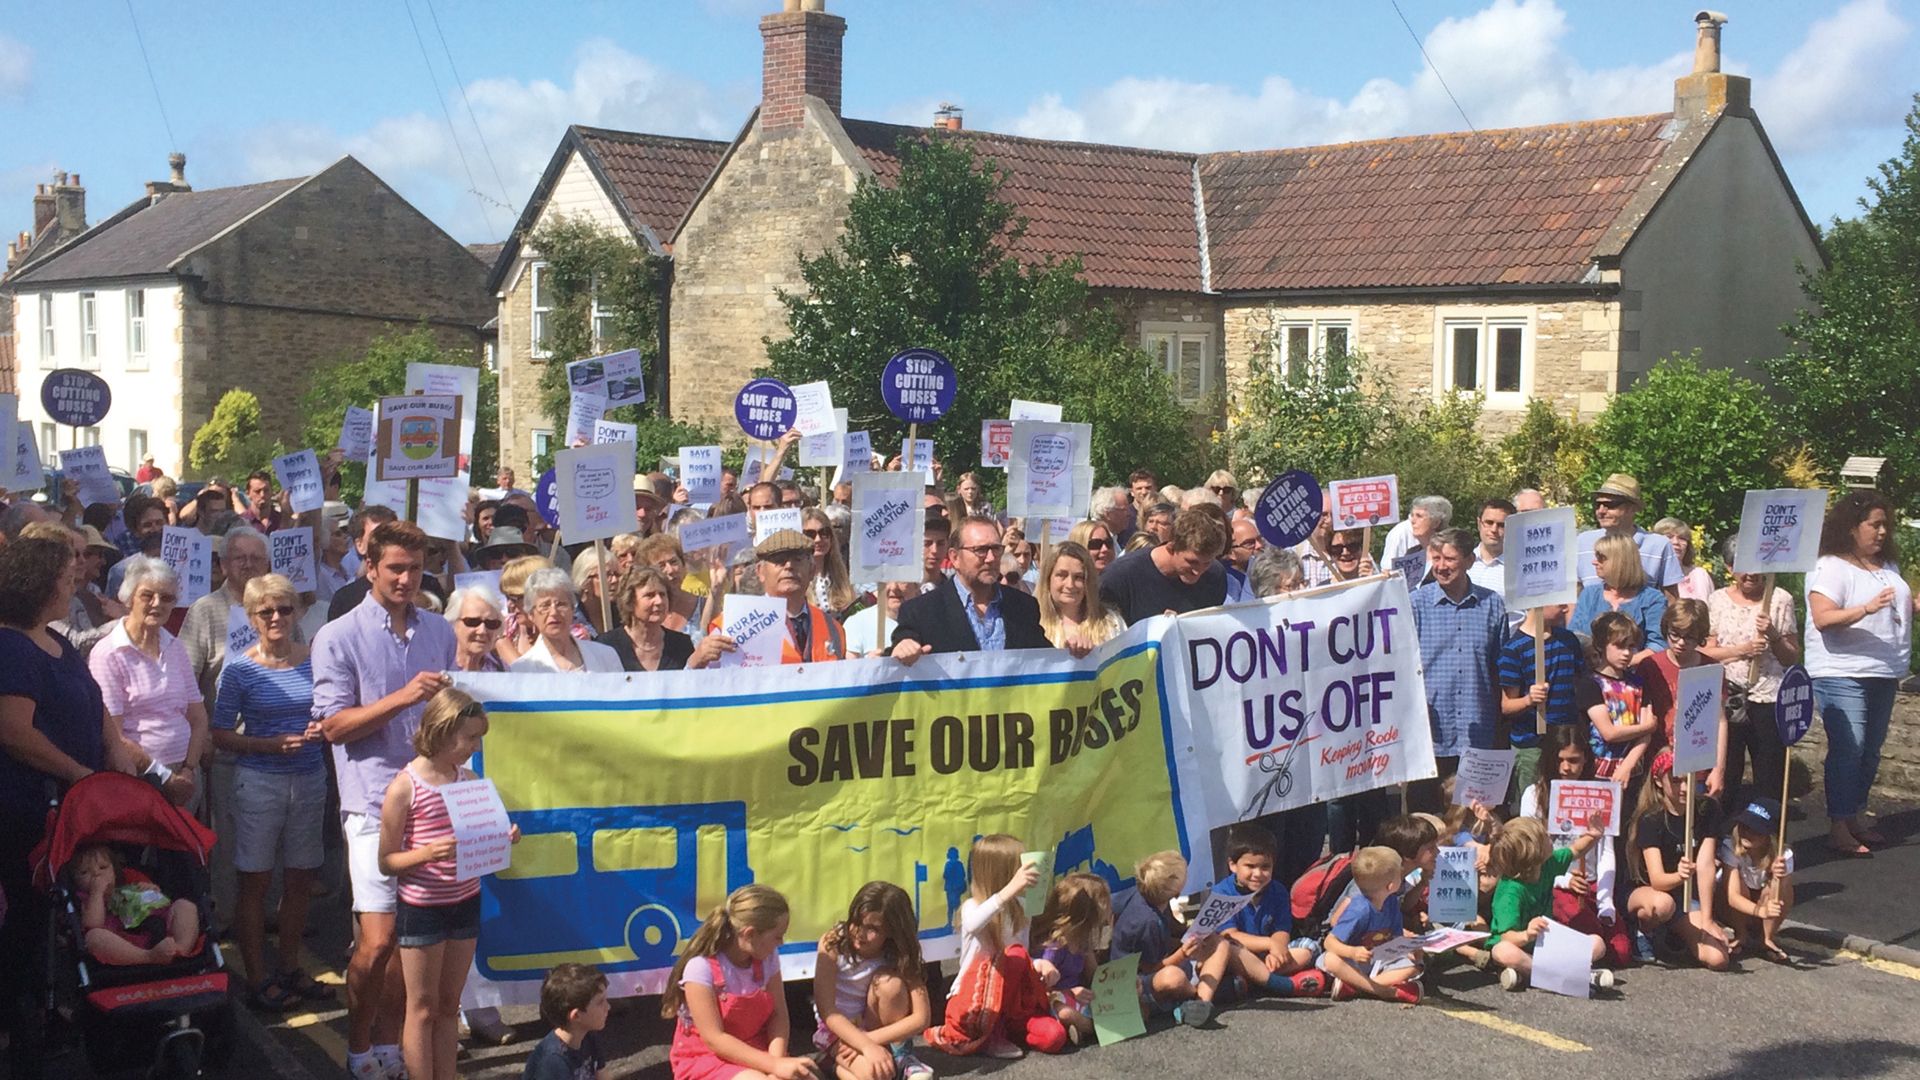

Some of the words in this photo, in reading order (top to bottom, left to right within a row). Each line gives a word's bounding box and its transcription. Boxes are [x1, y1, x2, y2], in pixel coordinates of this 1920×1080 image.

[906, 359, 935, 374] STOP
[62, 374, 91, 387] STOP
[895, 374, 944, 390] CUTTING
[52, 386, 100, 402] CUTTING
[742, 393, 768, 408] SAVE
[771, 397, 792, 410] OUR
[901, 390, 937, 405] BUSES
[58, 400, 93, 413] BUSES
[388, 403, 407, 413] SAVE
[749, 408, 782, 423] BUSES
[599, 426, 627, 439] DON'T
[1266, 480, 1291, 508] STOP
[865, 500, 897, 527] RURAL
[1266, 485, 1309, 527] CUTTING
[1765, 505, 1796, 514] DON'T
[759, 513, 779, 521] SAVE
[866, 500, 909, 538] ISOLATION
[1279, 501, 1311, 534] BUSES
[1764, 516, 1784, 525] CUT
[1784, 515, 1797, 526] US
[684, 530, 699, 539] SAVE
[699, 527, 712, 535] OUR
[712, 523, 725, 532] 267
[1527, 526, 1551, 536] SAVE
[1762, 526, 1780, 535] OFF
[165, 533, 187, 547] DON'T
[274, 535, 303, 547] DON'T
[164, 546, 178, 558] CUT
[179, 548, 188, 560] US
[274, 547, 292, 558] CUT
[295, 544, 308, 556] US
[274, 558, 292, 569] OFF
[1523, 562, 1538, 571] 267
[726, 609, 764, 636] RURAL
[733, 610, 779, 648] SOLATION
[742, 652, 762, 661] Save
[1188, 618, 1315, 690] DON'T
[1328, 608, 1398, 664] CUT
[1780, 687, 1796, 705] SAVE
[1244, 690, 1304, 749] US
[1322, 671, 1395, 732] OFF
[1684, 691, 1705, 719] RURAL
[1684, 689, 1713, 731] ISOLATION
[1785, 704, 1802, 722] BUSES
[787, 718, 915, 787] SAVE
[930, 712, 1035, 775] OUR
[1321, 739, 1362, 766] Keeping
[1365, 726, 1398, 749] Rode
[1346, 752, 1389, 780] moving
[448, 786, 470, 795] Keeping
[457, 798, 478, 806] Moving
[1444, 852, 1468, 860] SAVE
[1436, 887, 1454, 896] 267
[1204, 909, 1229, 918] CUT
